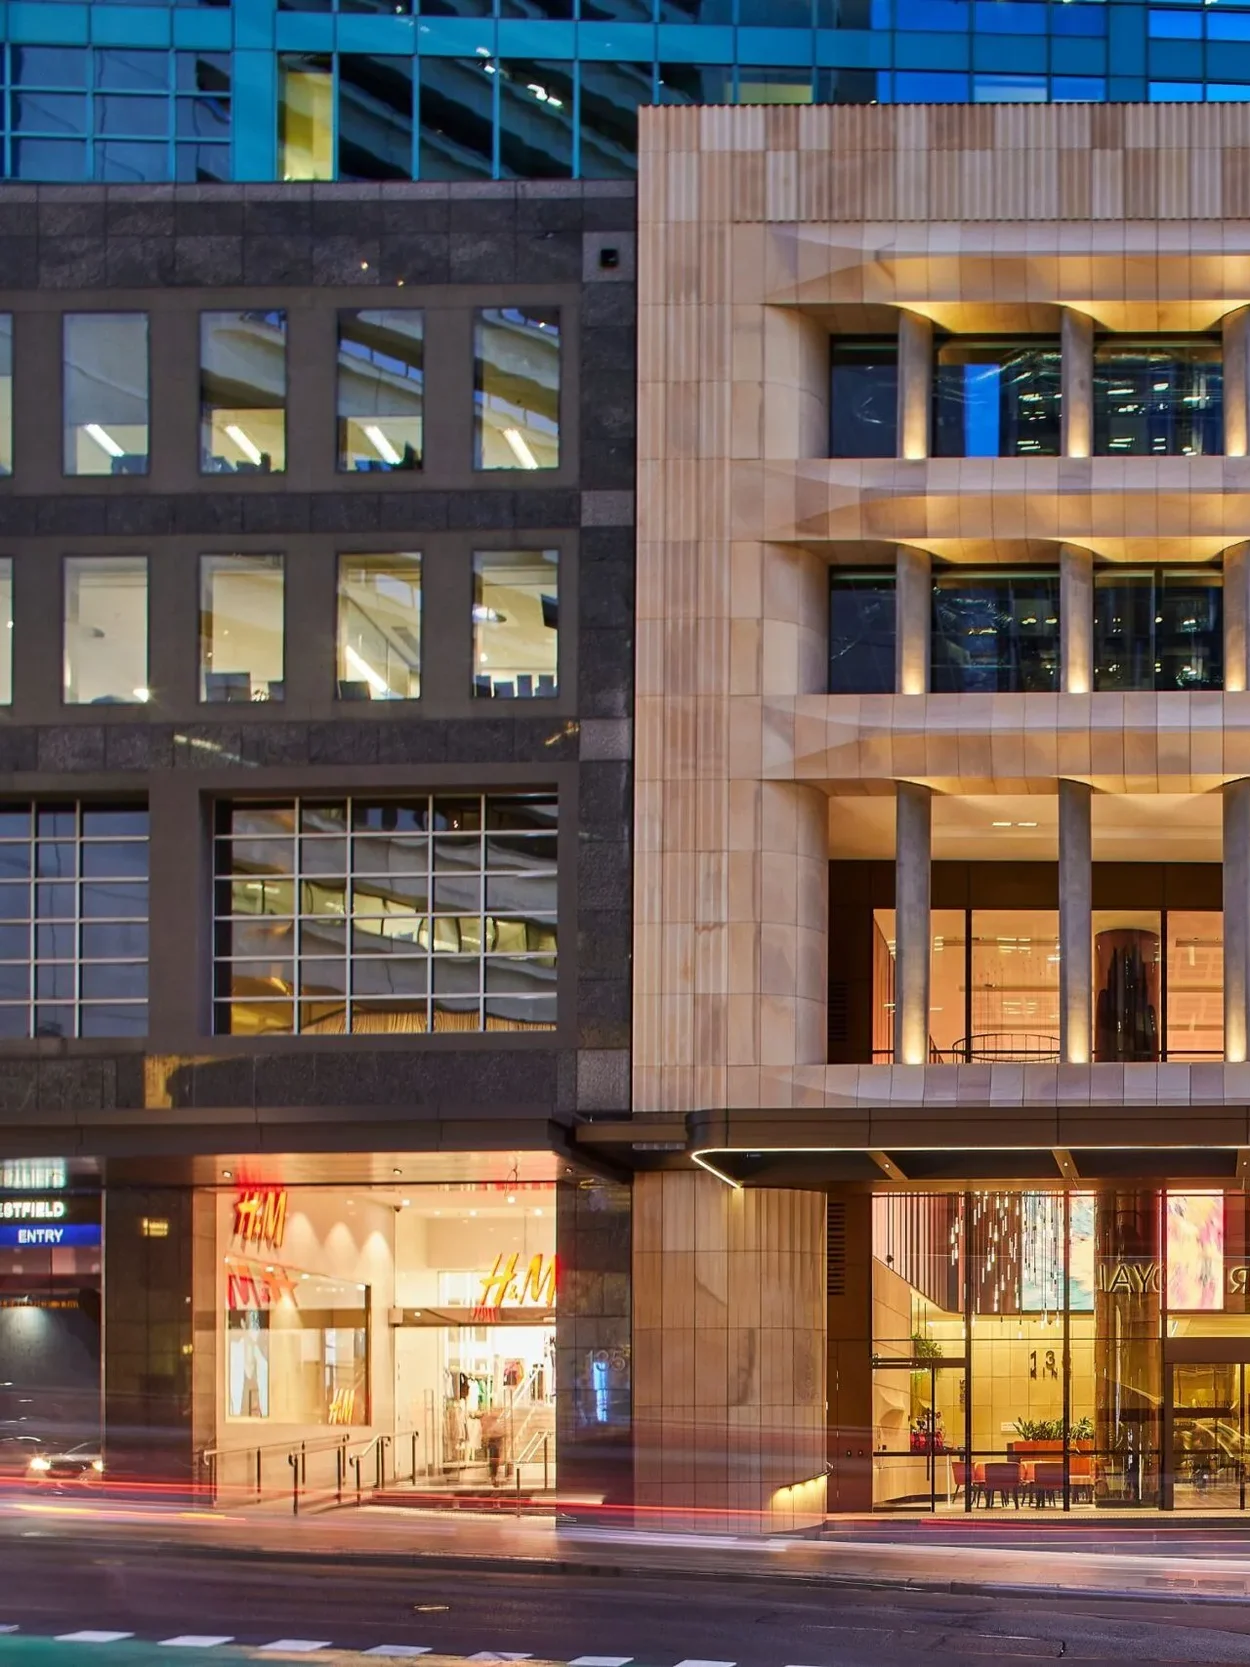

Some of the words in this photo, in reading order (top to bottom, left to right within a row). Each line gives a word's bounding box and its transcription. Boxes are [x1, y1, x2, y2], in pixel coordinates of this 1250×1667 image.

[18, 1229, 63, 1243] ENTRY
[235, 1191, 288, 1249] H&M
[480, 1253, 558, 1307] H&M
